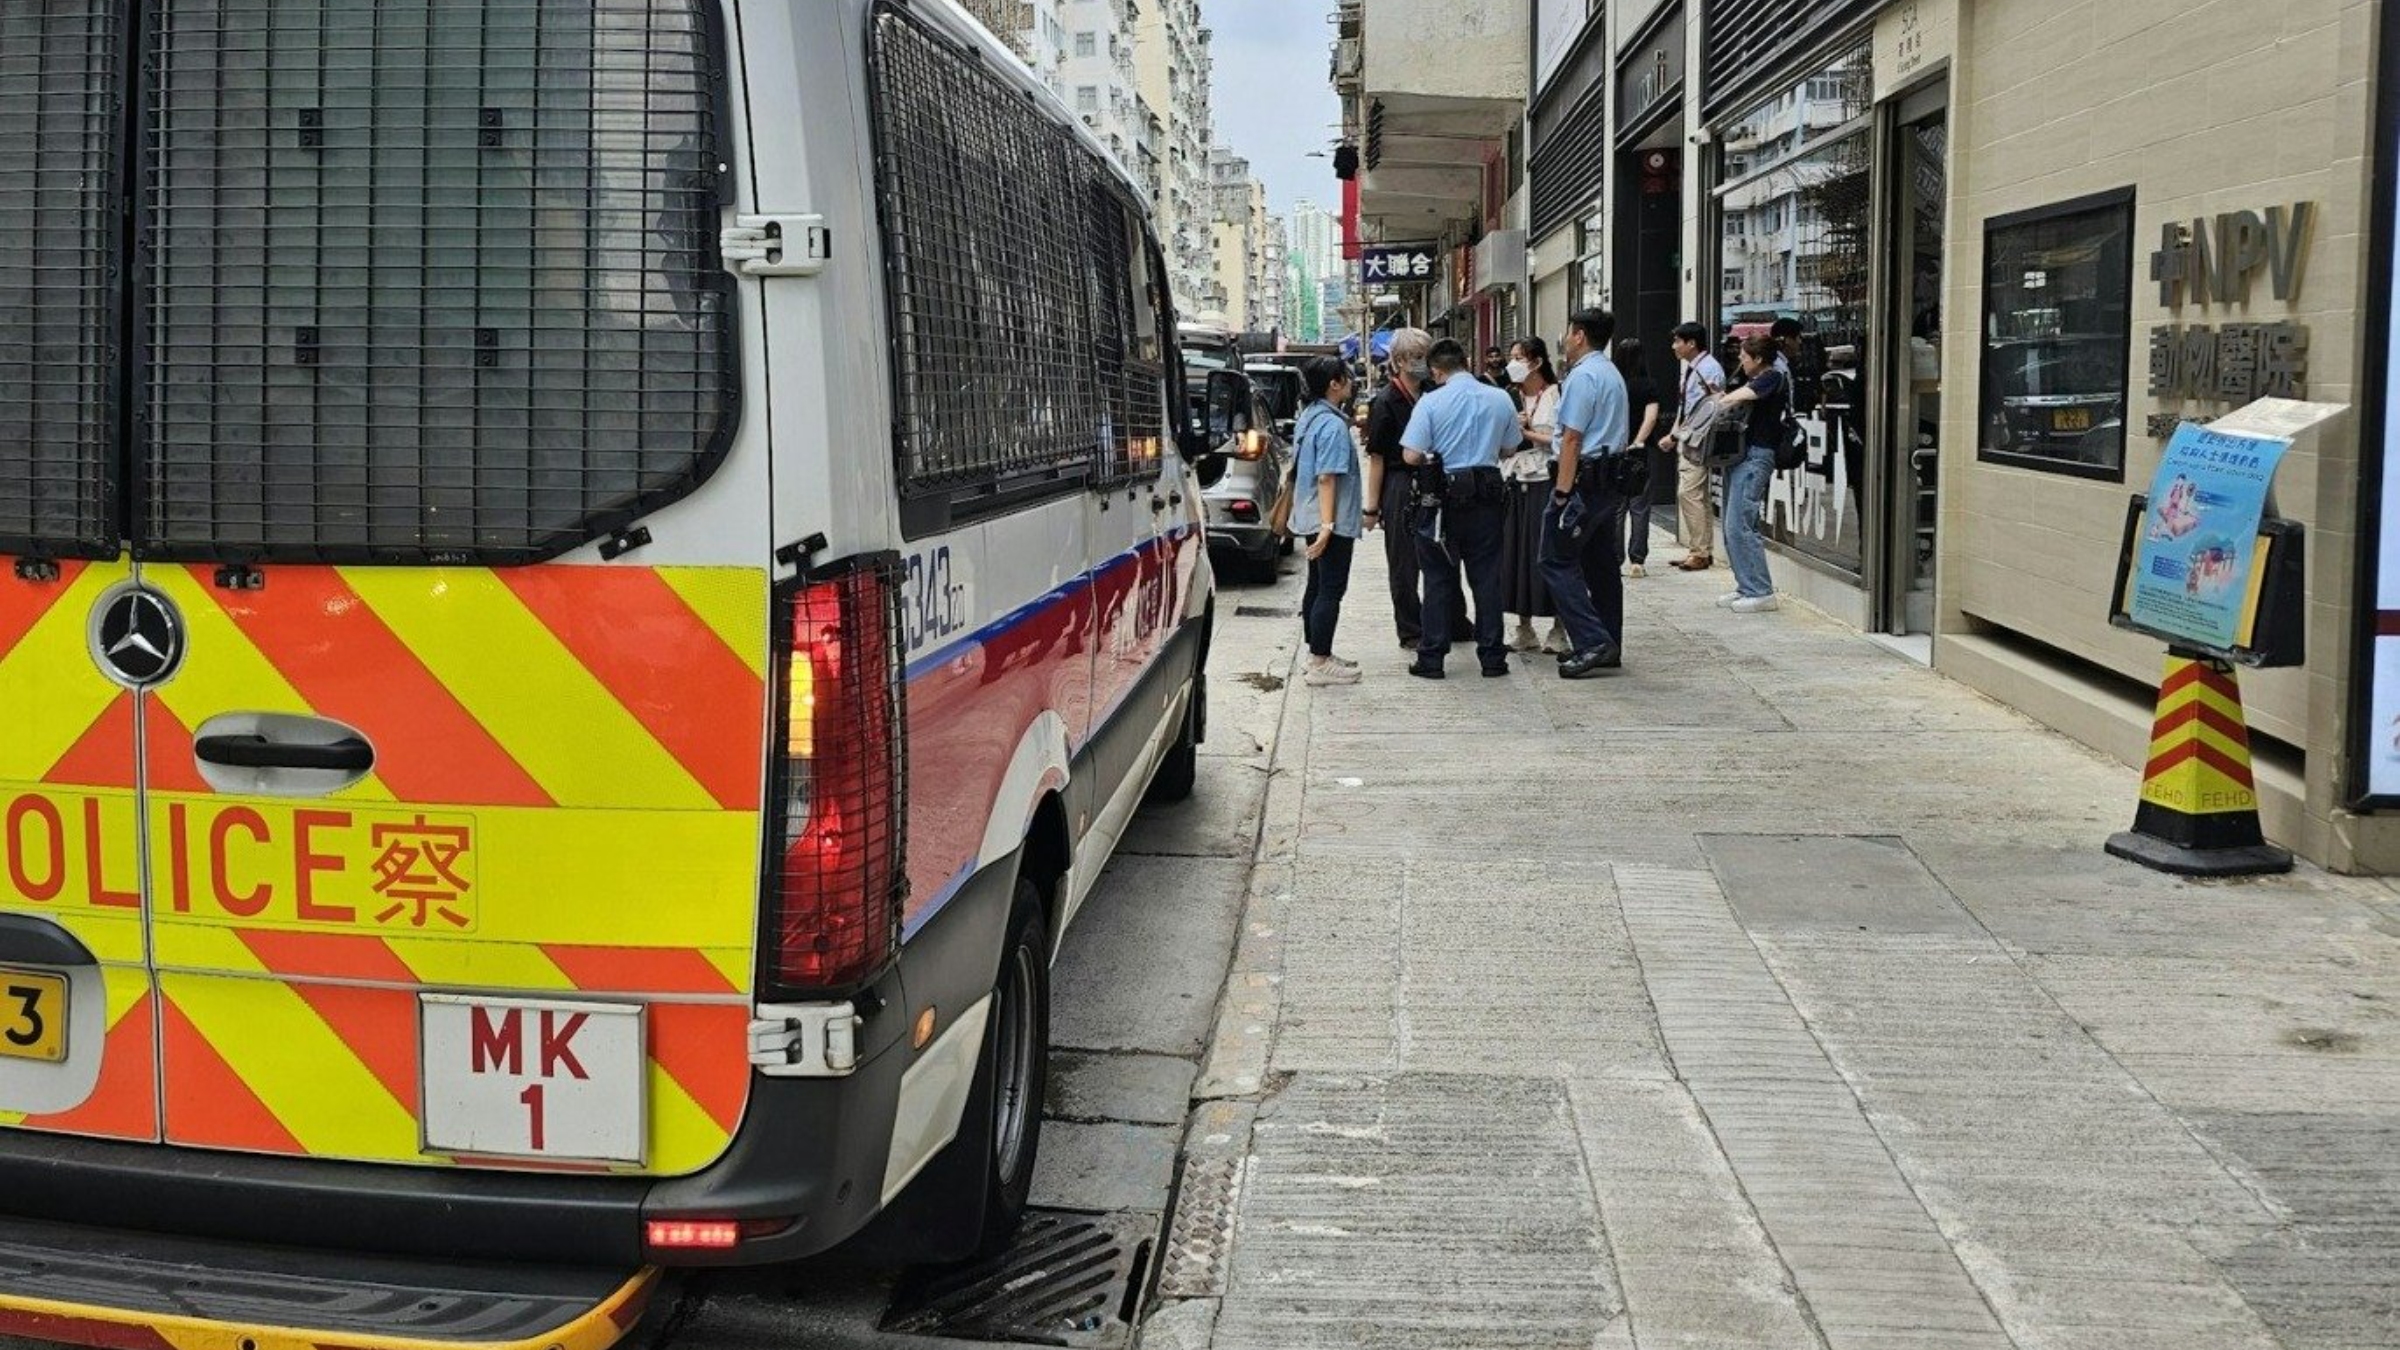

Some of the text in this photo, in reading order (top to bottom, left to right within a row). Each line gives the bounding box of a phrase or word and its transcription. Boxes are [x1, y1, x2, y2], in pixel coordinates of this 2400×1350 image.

[1365, 252, 1432, 277] 大聯合
[2191, 202, 2314, 305] NPV
[2148, 321, 2309, 402] 動物醫院
[2145, 782, 2184, 806] FEHD
[2201, 789, 2251, 808] FEHD
[370, 814, 470, 928] 察
[5, 985, 43, 1046] 3
[520, 1084, 543, 1150] 1
